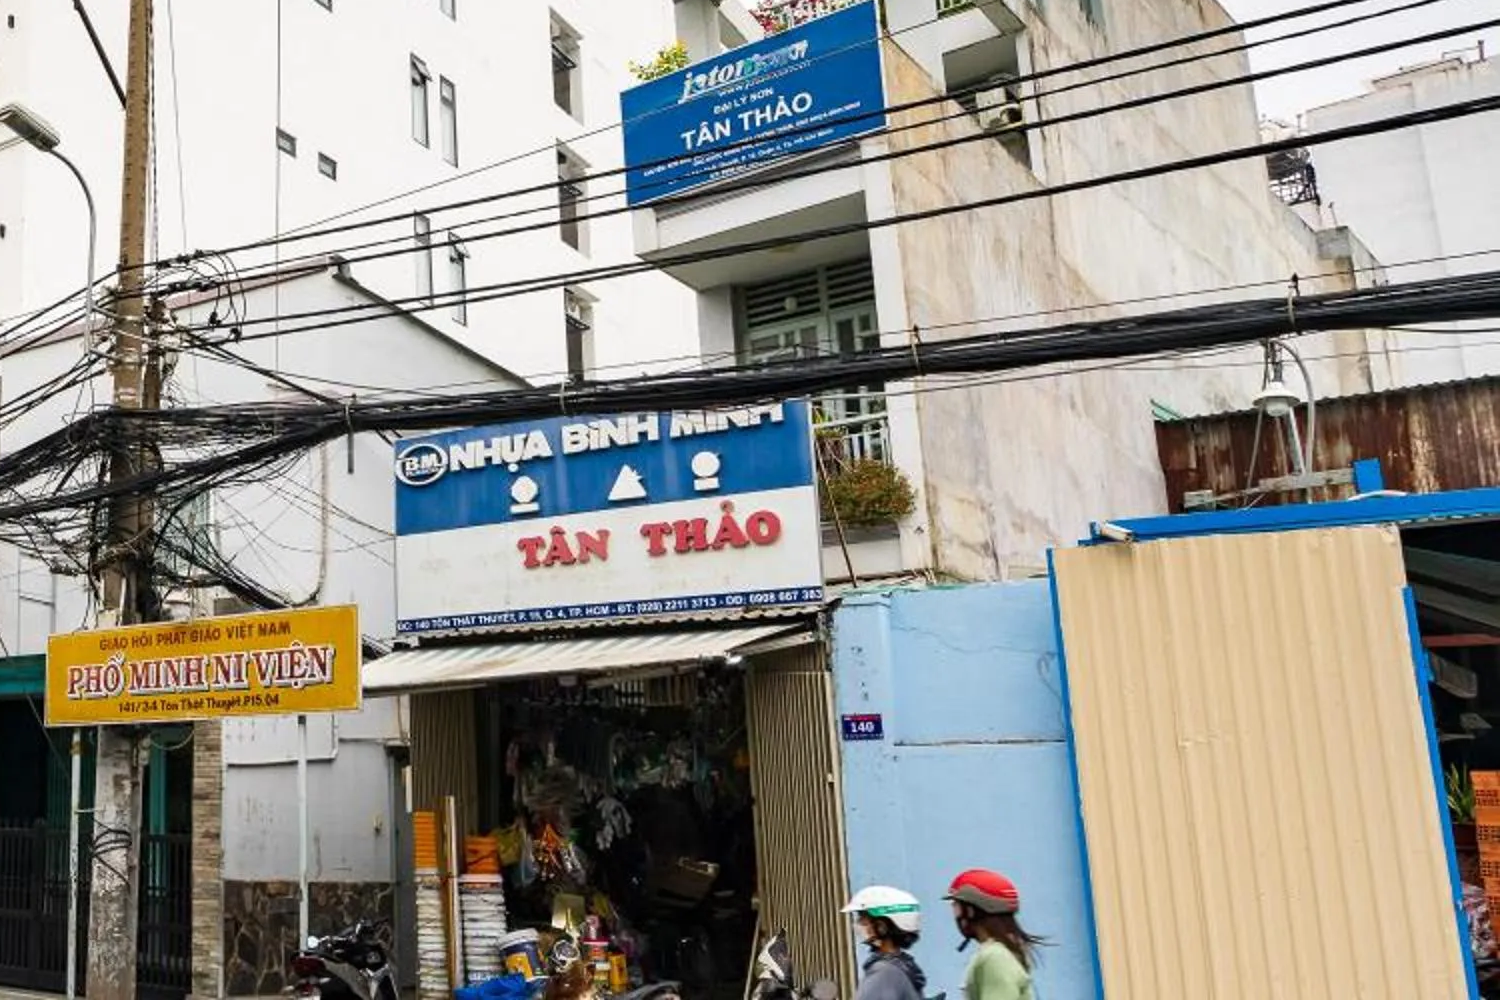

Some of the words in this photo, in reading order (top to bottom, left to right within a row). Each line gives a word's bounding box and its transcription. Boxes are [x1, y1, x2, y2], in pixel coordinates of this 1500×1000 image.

[680, 119, 732, 151] TÂN
[737, 91, 813, 132] THẢO
[518, 525, 611, 570] TÂN
[640, 499, 782, 558] THẢO
[257, 621, 291, 637] NAM
[129, 656, 208, 695] MINH
[212, 653, 249, 690] NI
[252, 641, 335, 688] VIỆN
[851, 721, 875, 733] 140
